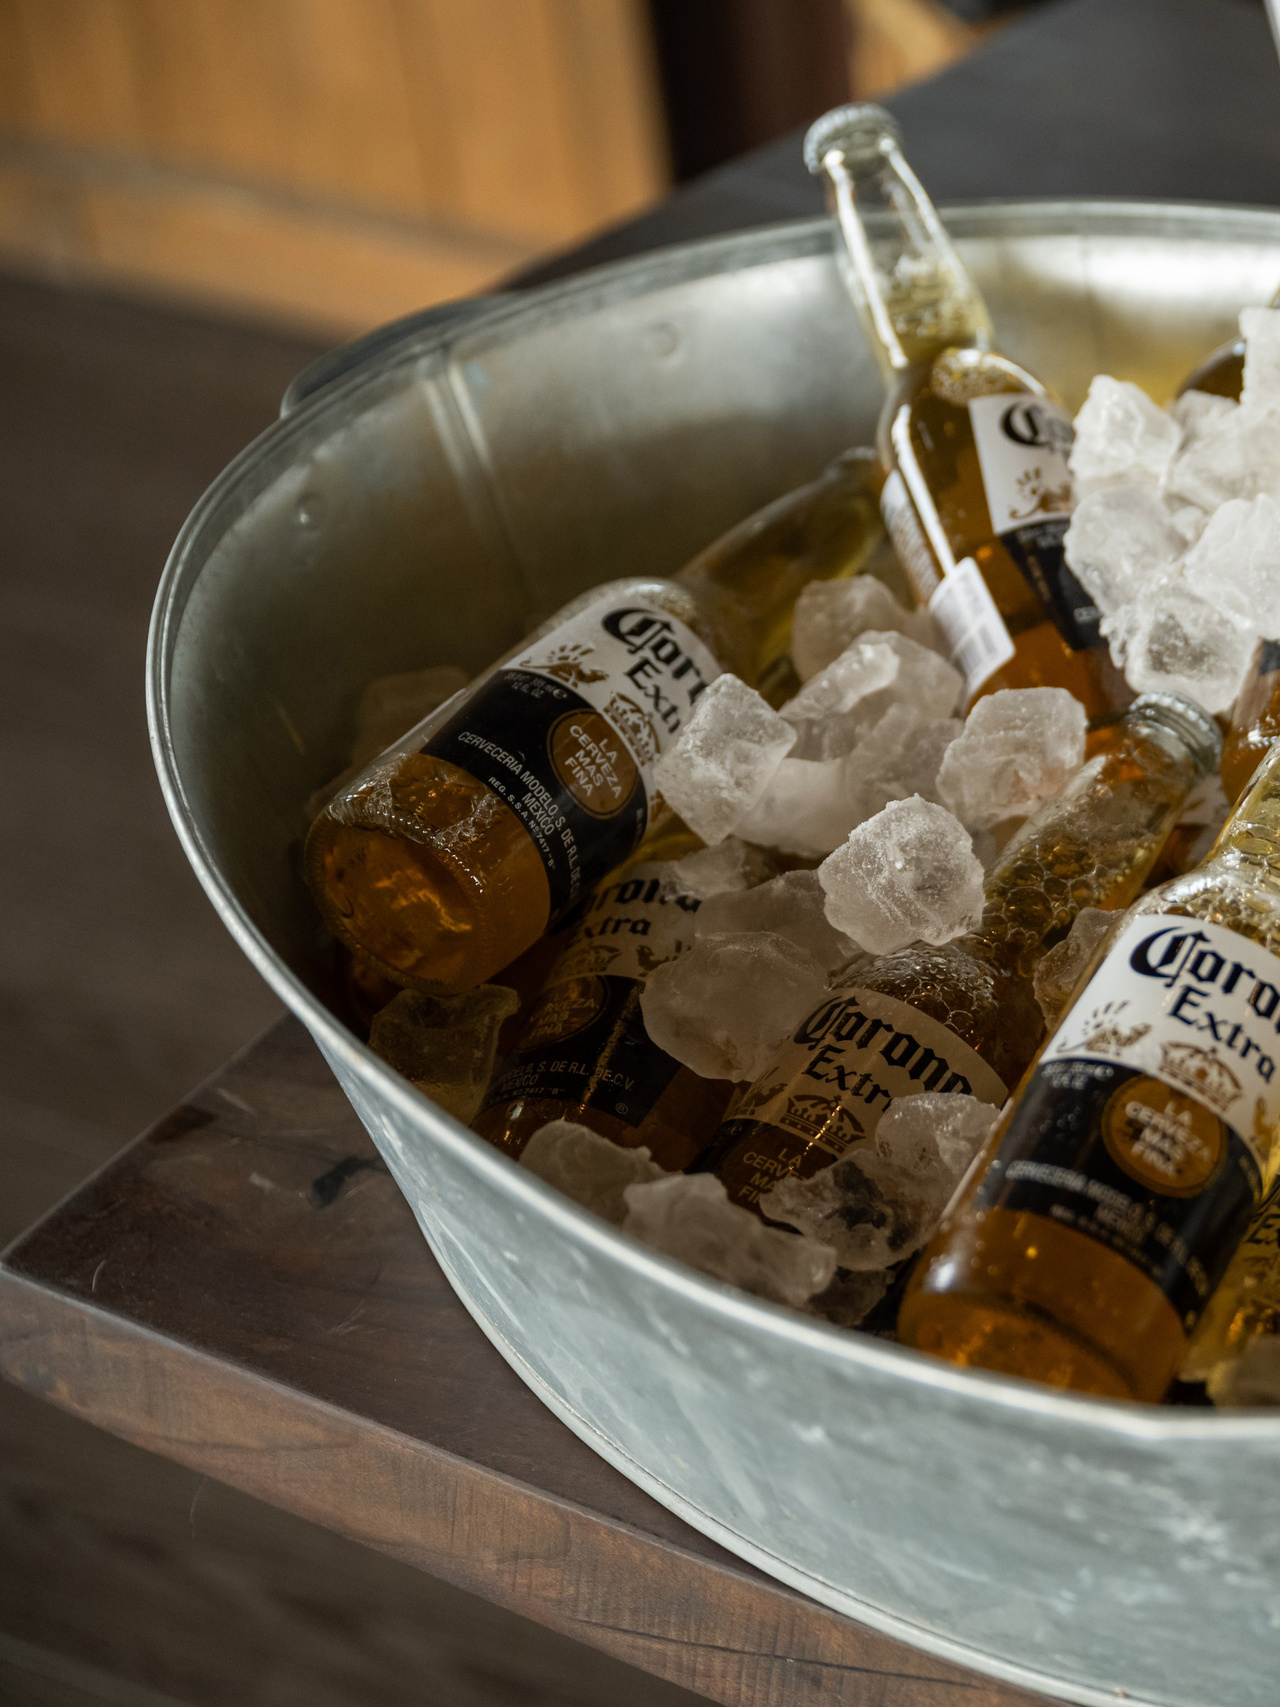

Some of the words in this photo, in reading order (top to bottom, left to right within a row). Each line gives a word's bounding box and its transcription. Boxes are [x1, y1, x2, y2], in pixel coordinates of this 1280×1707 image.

[570, 725, 622, 799] CERVEZA
[575, 750, 604, 787] MAS
[599, 738, 618, 764] LA
[458, 731, 523, 775] CERVECERIA
[561, 828, 574, 848] DE
[564, 757, 593, 796] FINA
[488, 776, 507, 797] REG.
[536, 831, 550, 852] 7417
[522, 793, 554, 835] MEXICO
[1169, 984, 1276, 1084] Extra
[549, 1061, 568, 1073] DE
[568, 1061, 589, 1076] R.L.
[801, 1044, 893, 1112] Extr
[778, 1148, 802, 1169] LA
[738, 1185, 759, 1203] FI
[750, 1172, 778, 1190] MA
